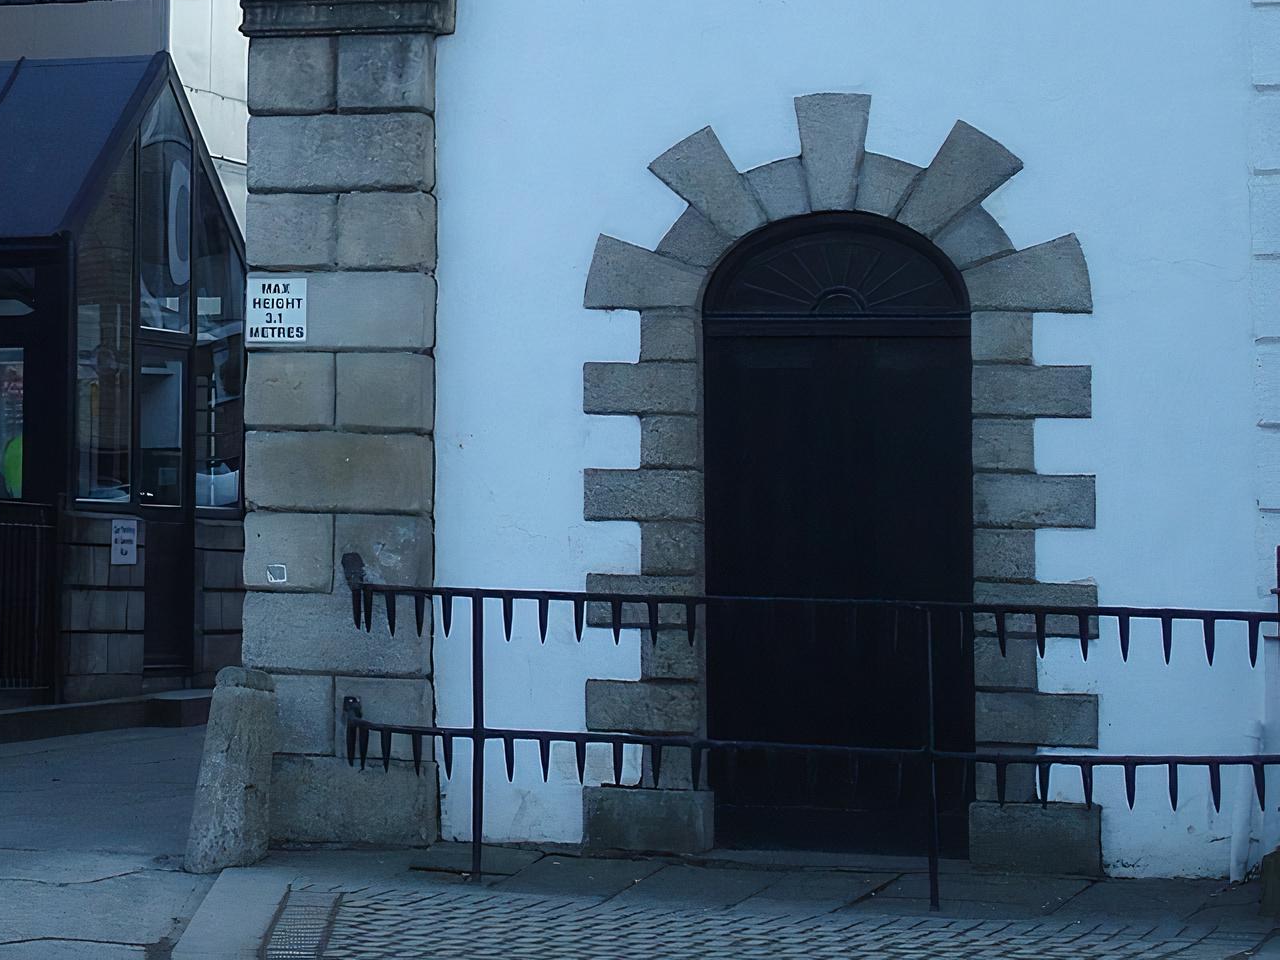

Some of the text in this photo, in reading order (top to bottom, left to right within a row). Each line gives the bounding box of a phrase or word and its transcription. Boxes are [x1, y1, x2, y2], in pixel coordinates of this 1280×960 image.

[261, 283, 290, 294] MAX
[252, 298, 303, 309] HEIGHT
[265, 312, 283, 324] 3.1
[249, 326, 304, 338] METRES
